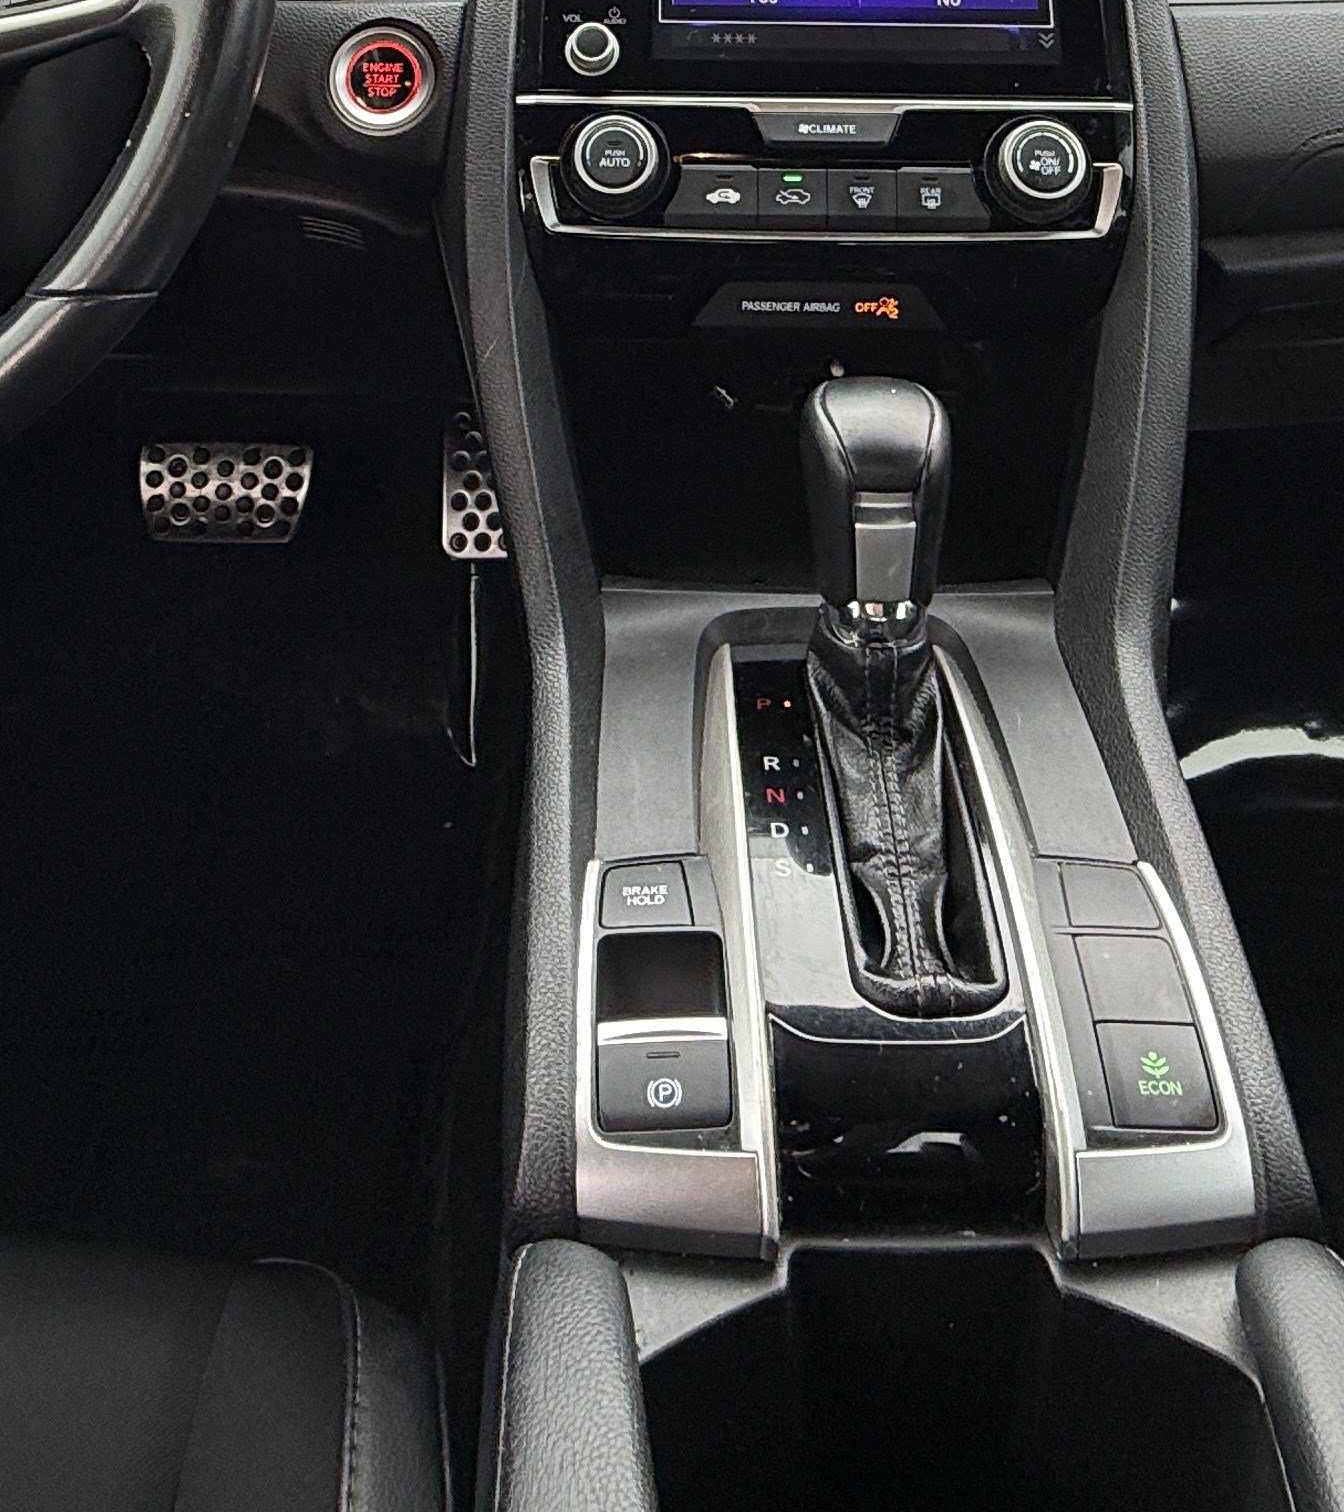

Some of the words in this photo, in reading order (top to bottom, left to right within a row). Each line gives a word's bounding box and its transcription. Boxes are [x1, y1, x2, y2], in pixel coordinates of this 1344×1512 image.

[562, 13, 584, 23] VOL
[362, 62, 405, 73] ENGINE
[364, 73, 400, 84] START
[367, 87, 397, 98] STOP
[808, 124, 856, 134] CLIMATE
[598, 157, 630, 168] AUTO
[1040, 165, 1061, 176] OFF
[849, 186, 875, 194] FRONT
[741, 300, 800, 312] PASSENGER
[803, 302, 840, 312] AIRBAG
[854, 302, 879, 313] OFF
[757, 698, 771, 709] P
[763, 756, 781, 771] R
[766, 788, 786, 804] N
[770, 822, 789, 838] D
[775, 859, 791, 877] S
[622, 885, 668, 896] BRAKE
[627, 895, 665, 906] HOLD
[1138, 1080, 1183, 1096] ECON
